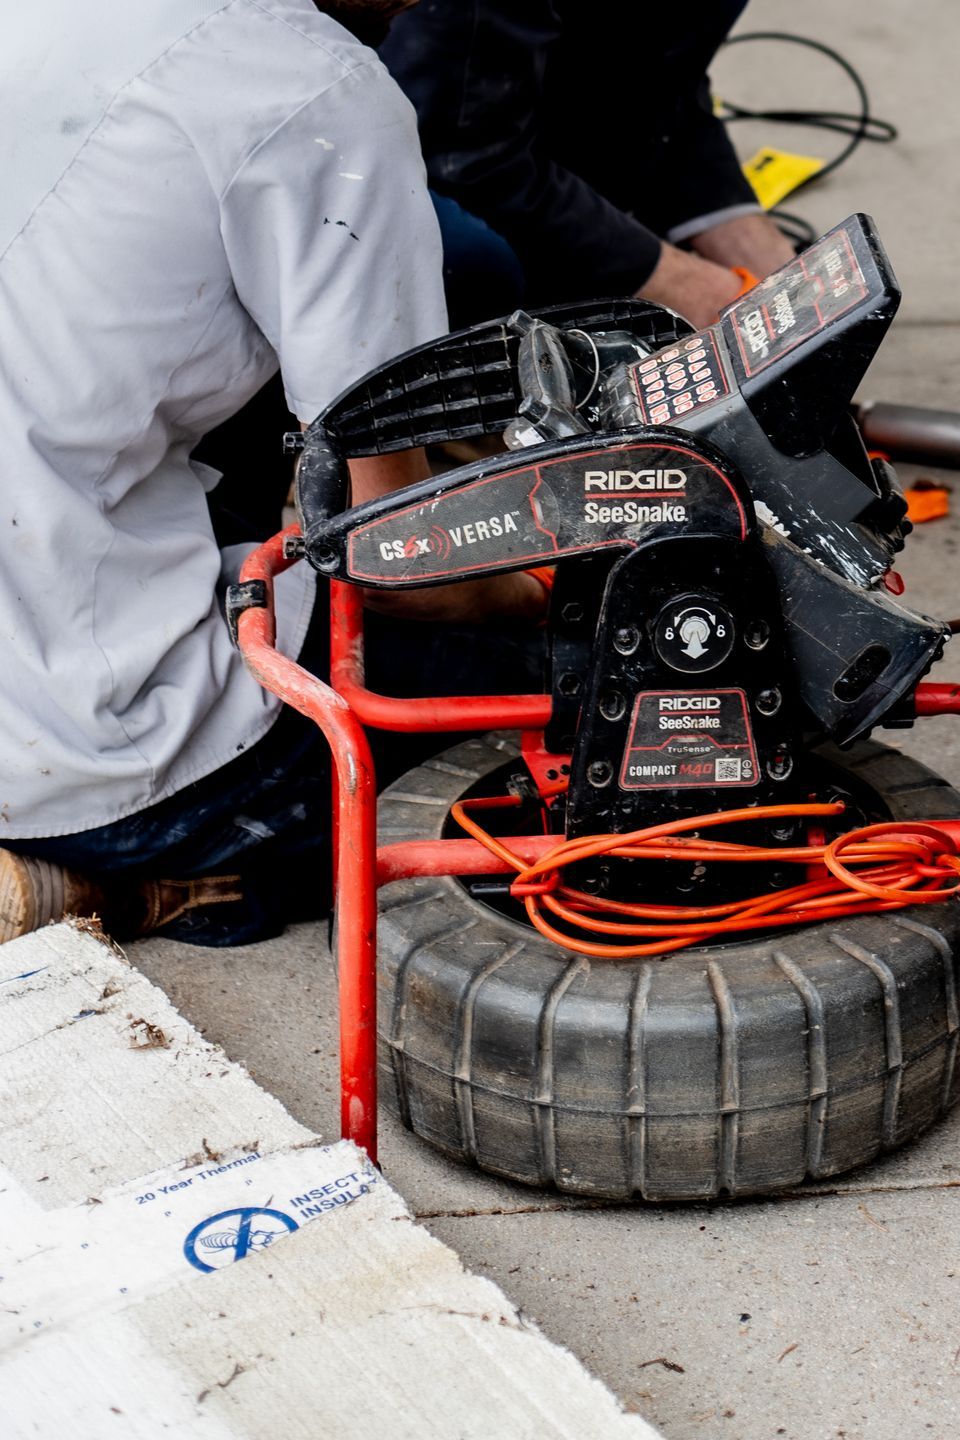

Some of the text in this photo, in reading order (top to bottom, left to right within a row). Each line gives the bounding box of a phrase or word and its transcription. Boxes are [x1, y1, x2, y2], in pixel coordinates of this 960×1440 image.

[743, 309, 770, 354] RIDGID
[584, 469, 688, 491] RIDGID
[584, 501, 688, 524] SeeSnake
[658, 697, 721, 711] RIDGID
[658, 715, 721, 730] SeeSnake
[629, 763, 713, 777] COMPACT M40
[134, 1151, 262, 1205] 20 Year Thermal
[290, 1172, 359, 1208] INSECT
